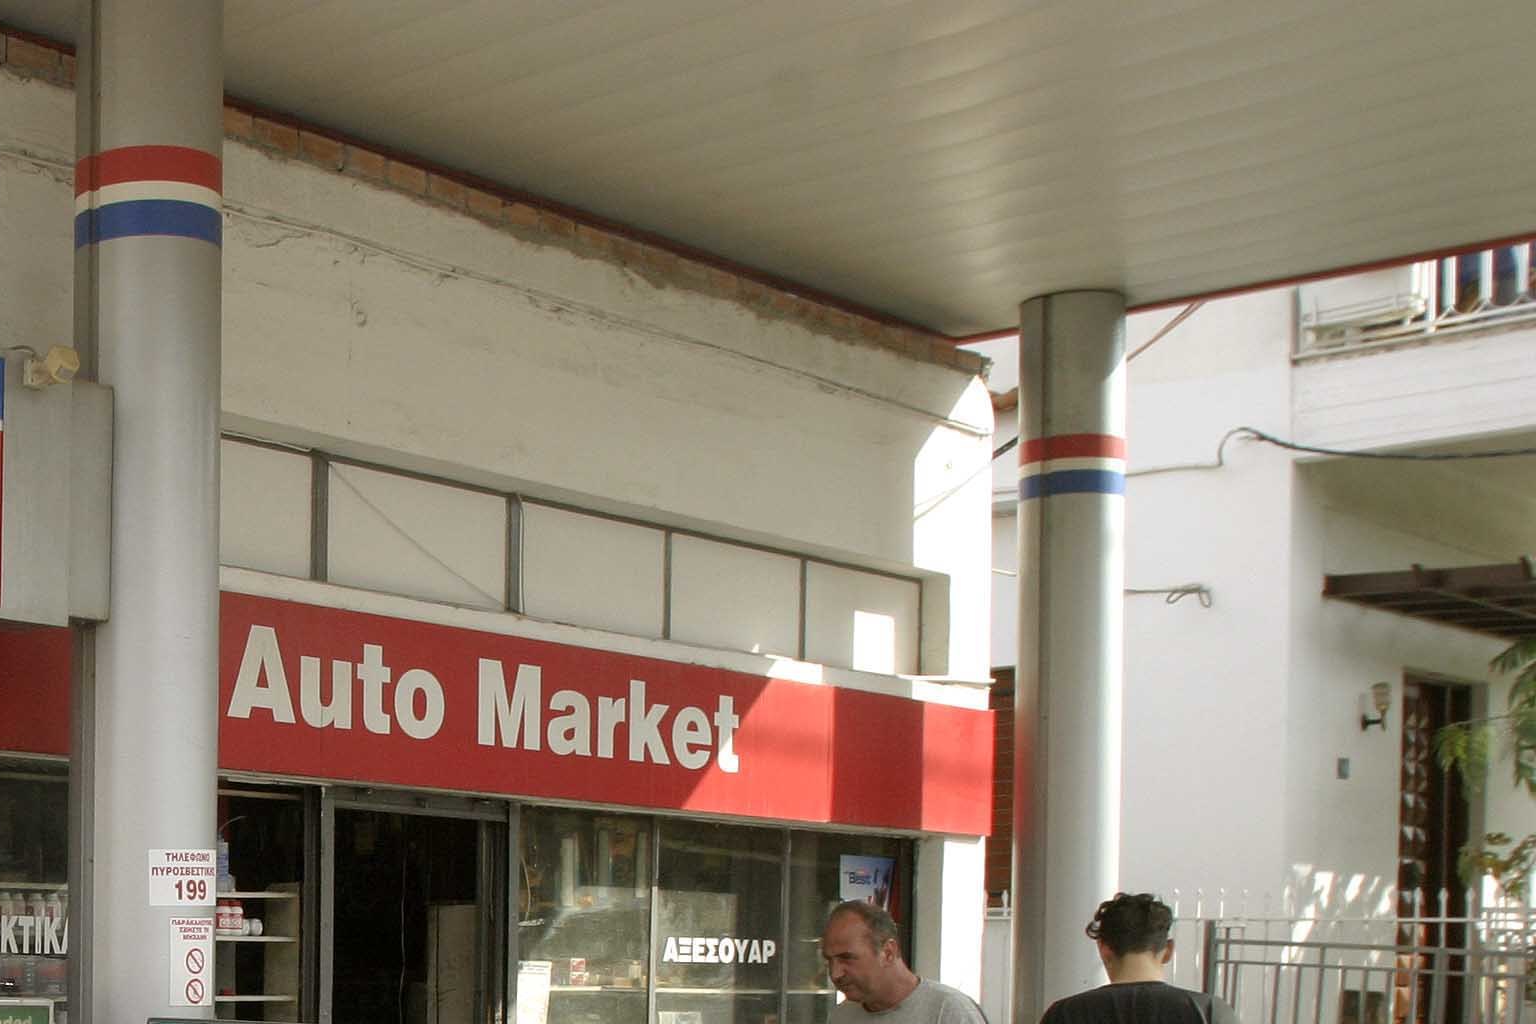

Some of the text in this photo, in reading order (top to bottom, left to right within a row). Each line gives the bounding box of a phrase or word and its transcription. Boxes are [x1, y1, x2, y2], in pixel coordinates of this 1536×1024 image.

[226, 624, 740, 774] Auto Market
[175, 879, 207, 901] 199
[663, 936, 776, 964] ΑΞΕΣΟΥΑΡ
